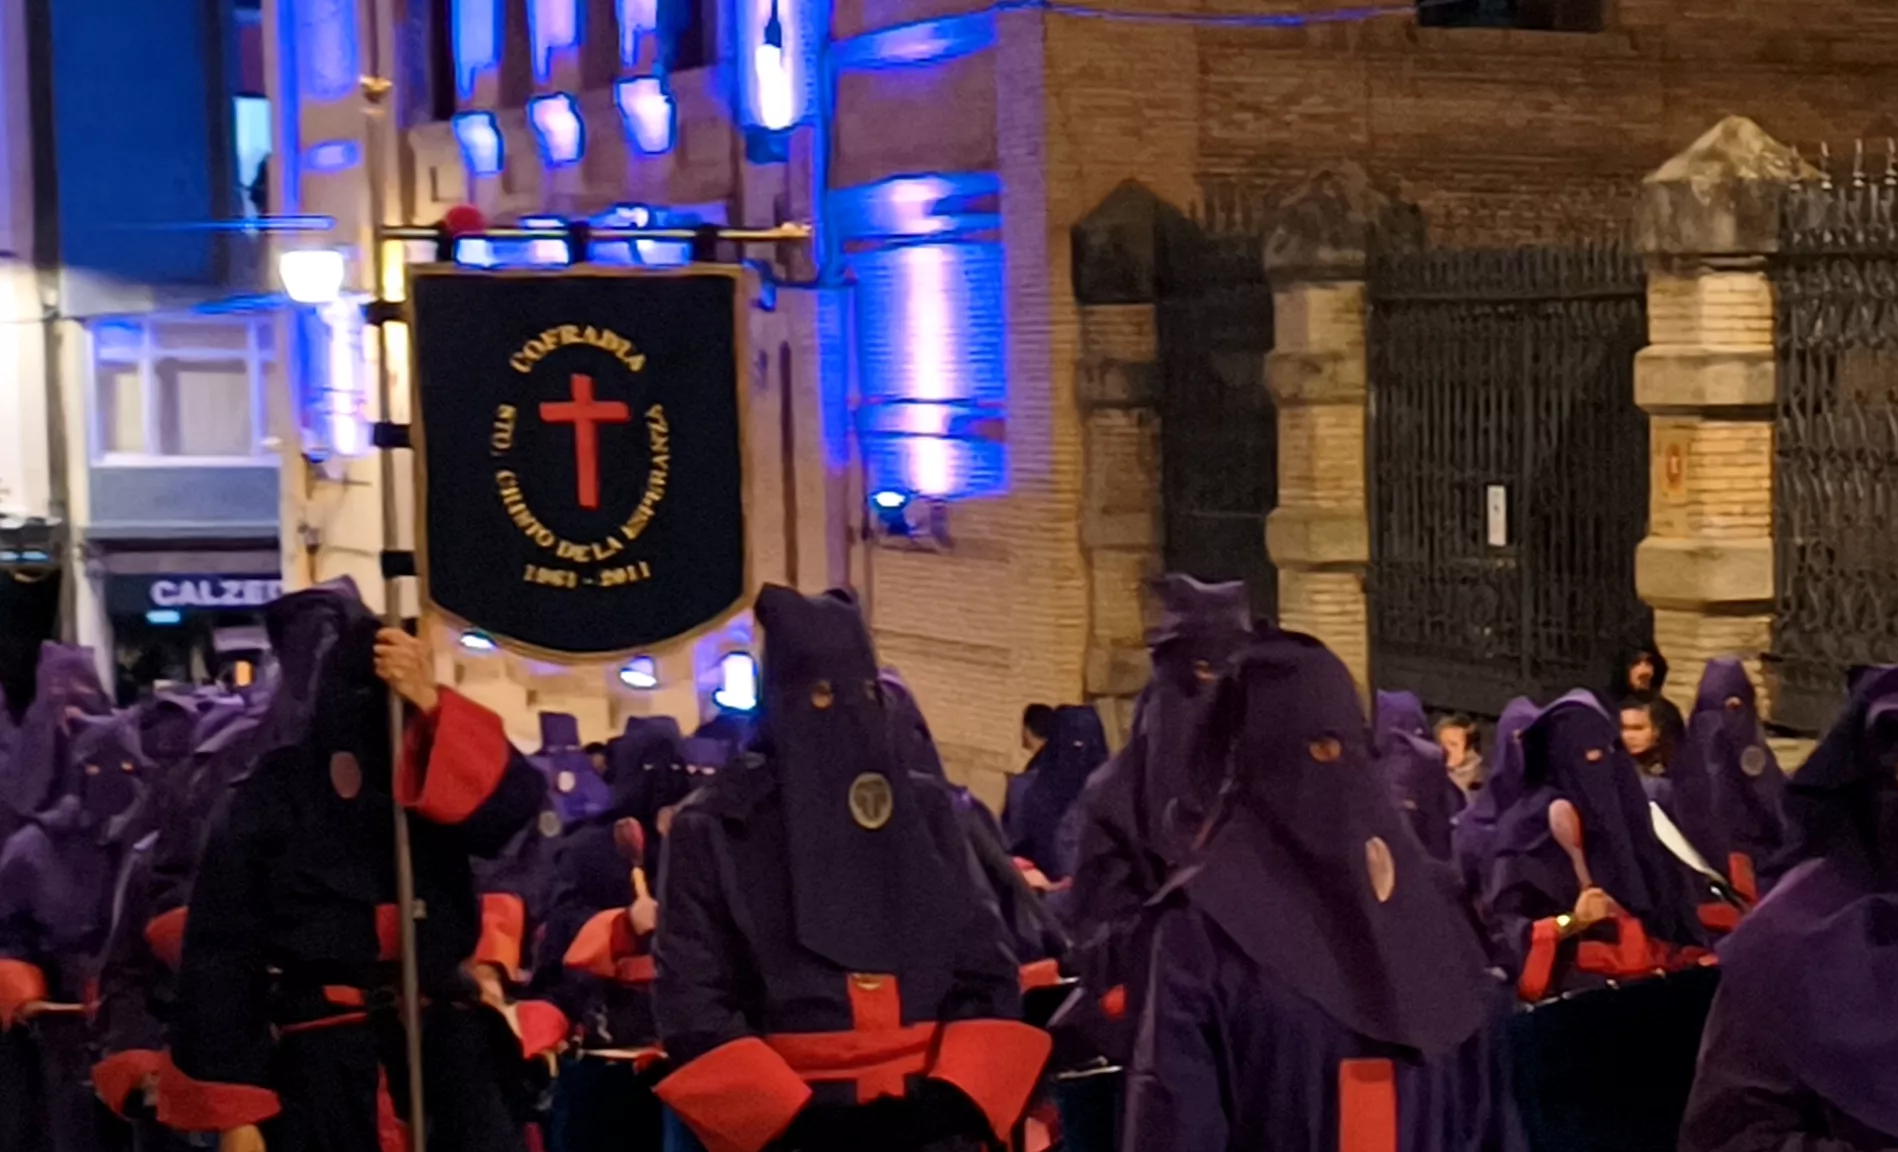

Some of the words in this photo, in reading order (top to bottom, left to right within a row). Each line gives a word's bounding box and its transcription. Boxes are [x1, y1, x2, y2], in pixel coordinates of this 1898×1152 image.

[496, 469, 556, 547] CRISTO
[556, 539, 592, 562] DE
[591, 536, 624, 560] LA
[620, 403, 671, 540] ESPERANZA
